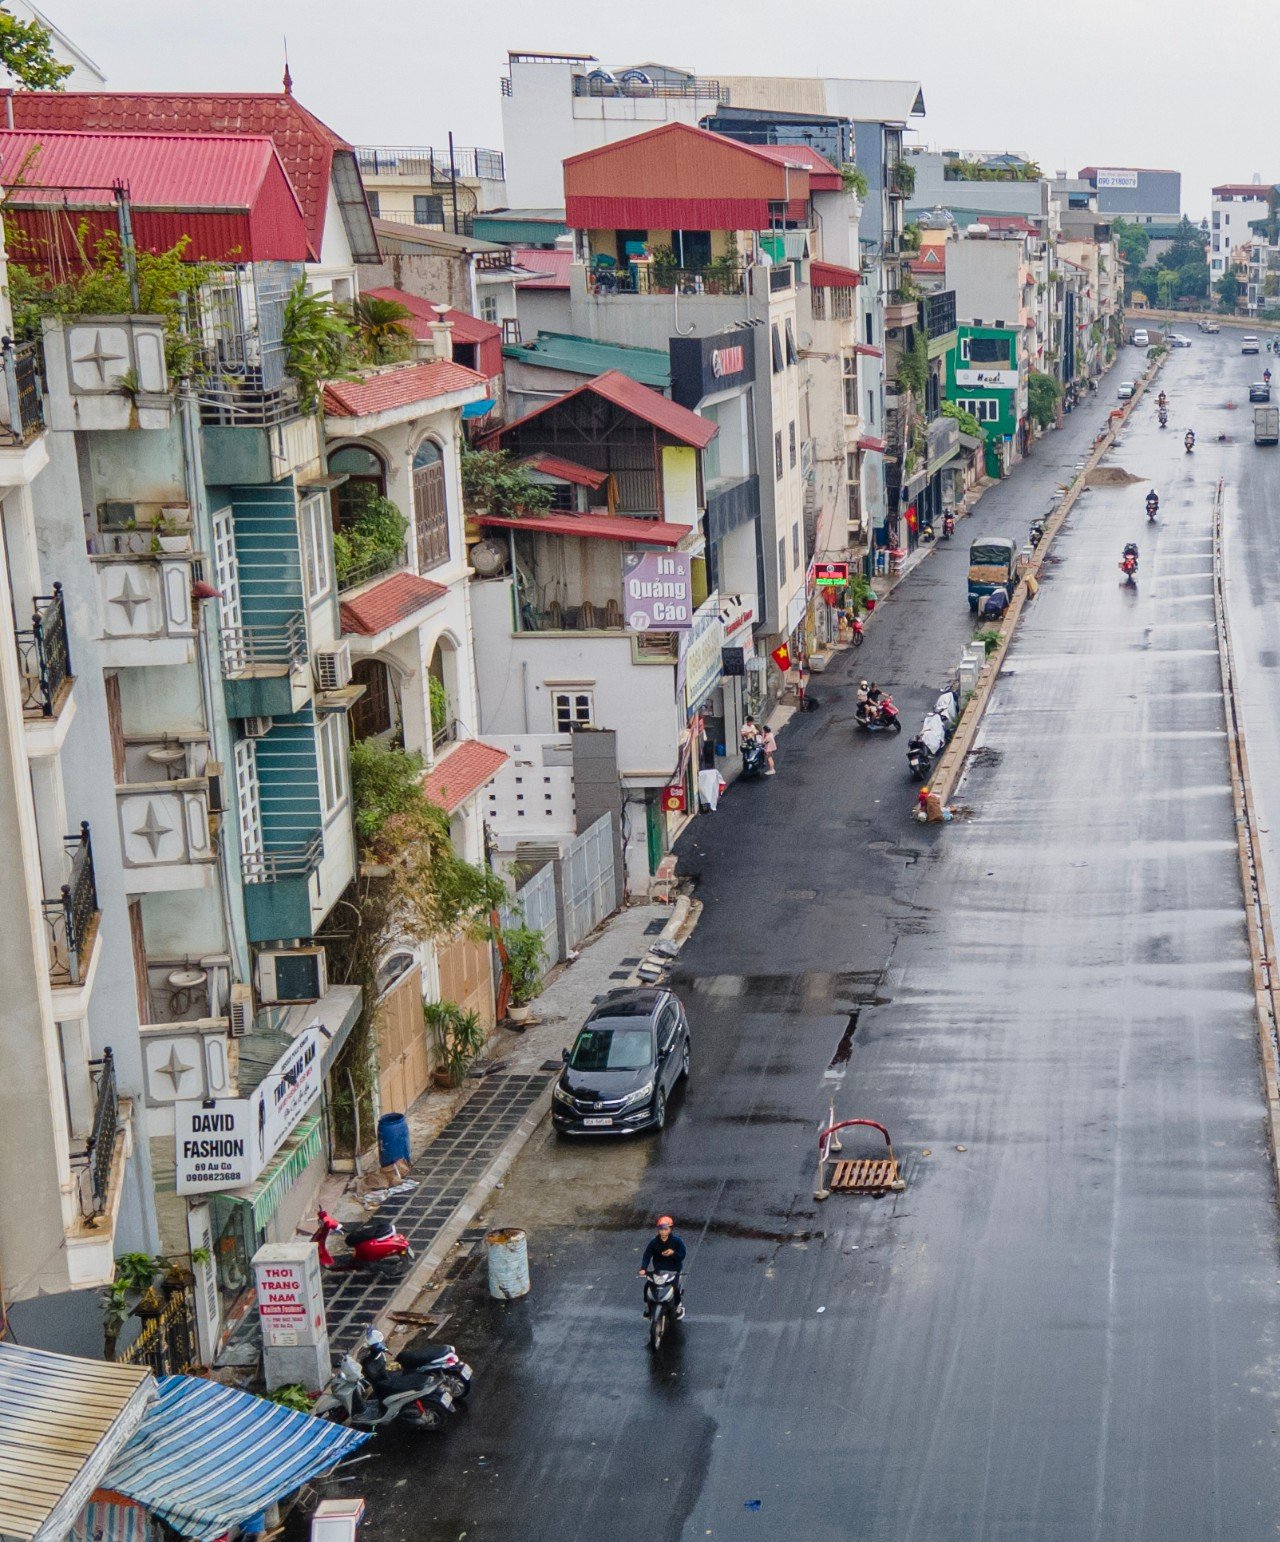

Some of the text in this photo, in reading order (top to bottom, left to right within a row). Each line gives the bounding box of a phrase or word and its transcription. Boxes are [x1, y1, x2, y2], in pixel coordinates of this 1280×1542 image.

[657, 556, 685, 575] In &
[629, 577, 686, 599] Quảng
[653, 602, 687, 621] Cáo
[192, 1113, 234, 1132] DAVID
[183, 1139, 244, 1158] FASHION
[261, 1282, 300, 1290] TRANG
[269, 1293, 295, 1302] NAM
